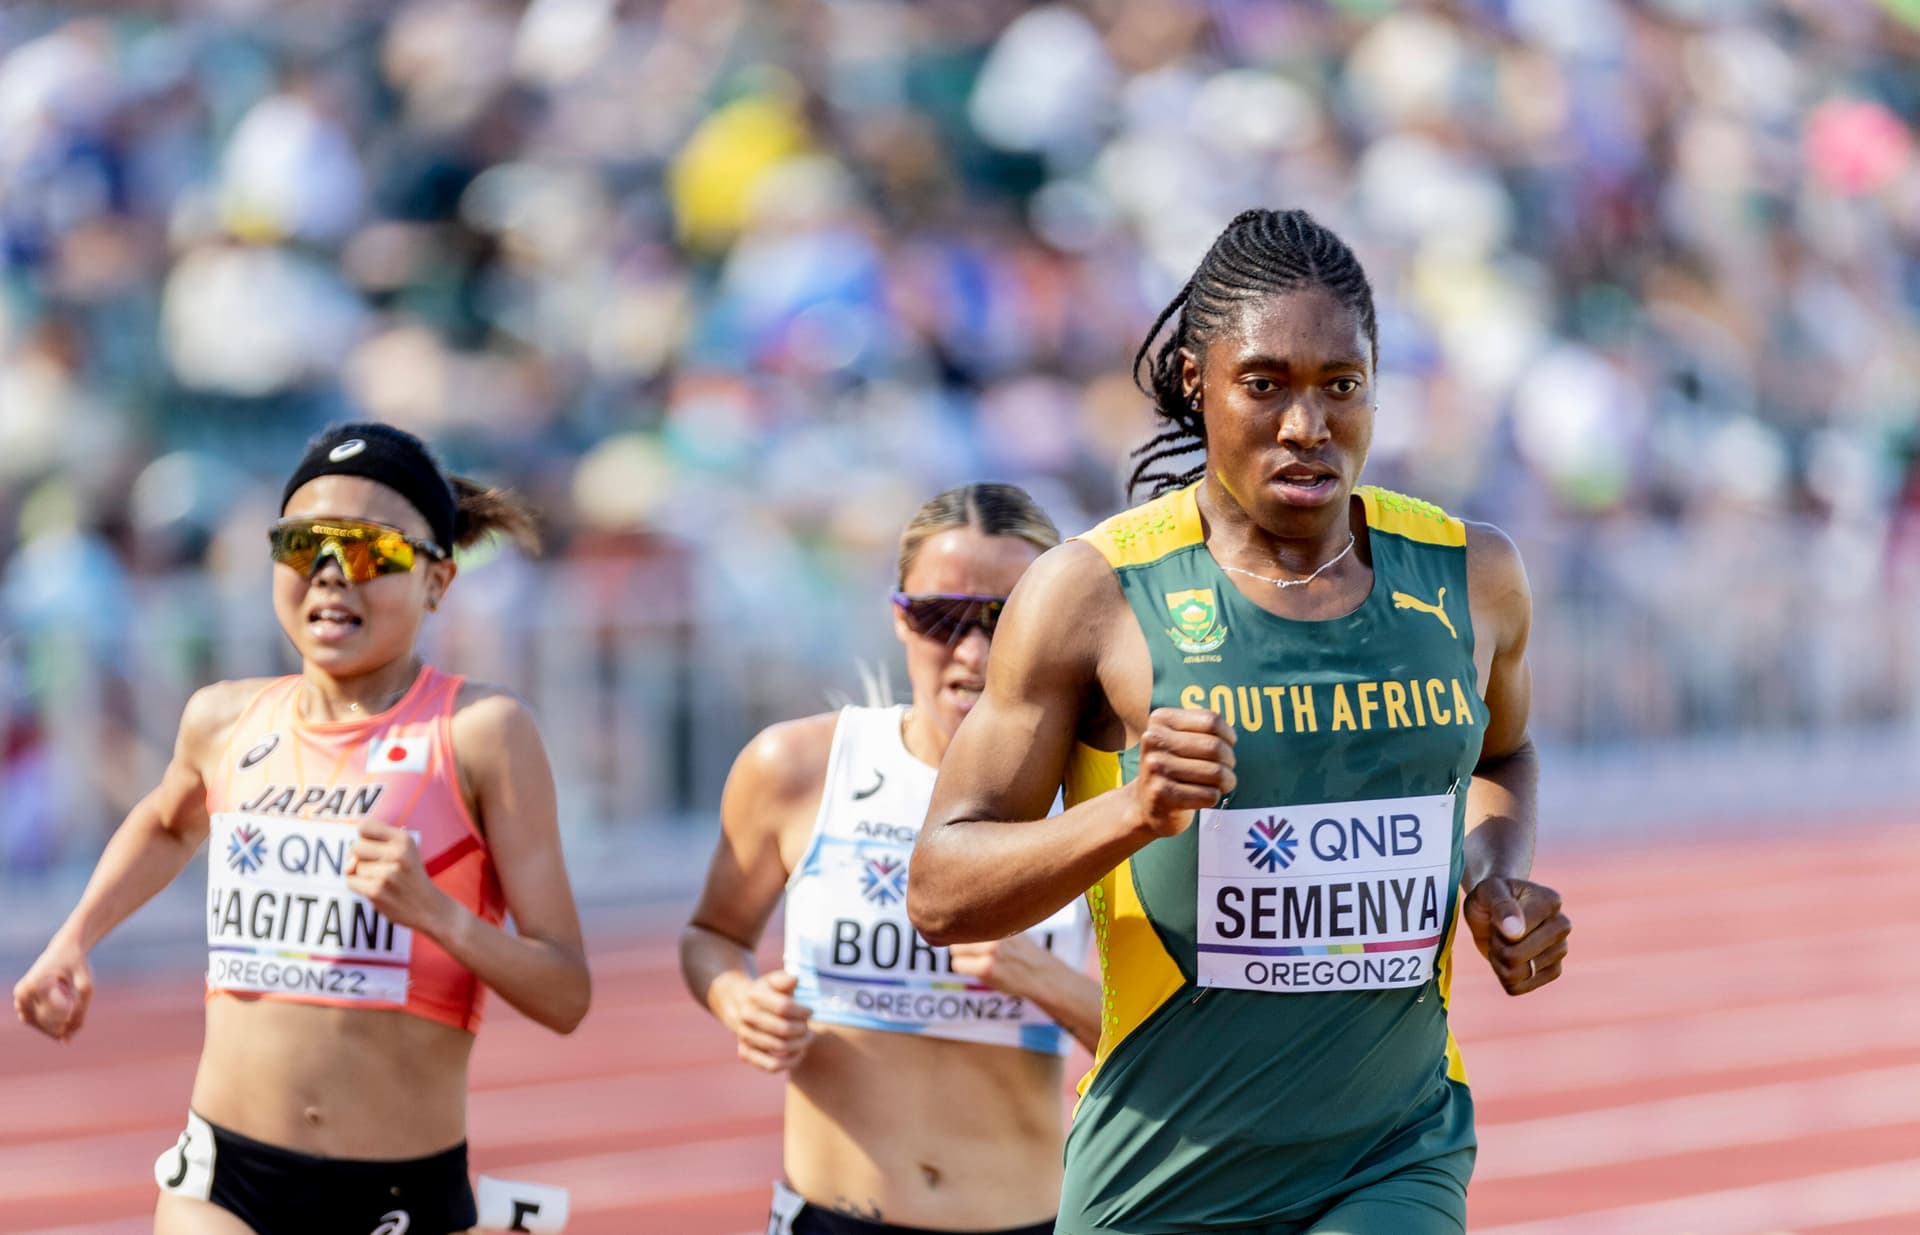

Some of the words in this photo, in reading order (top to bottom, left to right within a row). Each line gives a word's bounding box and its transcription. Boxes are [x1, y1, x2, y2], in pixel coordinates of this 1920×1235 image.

[1331, 678, 1474, 731] AFRICA
[240, 784, 383, 816] JAPAN
[278, 834, 354, 876] QN
[1309, 814, 1423, 862] QNB
[1215, 876, 1440, 940] SEMENYA
[1244, 956, 1421, 986] OREGON22
[854, 990, 1024, 1020] OREGON22
